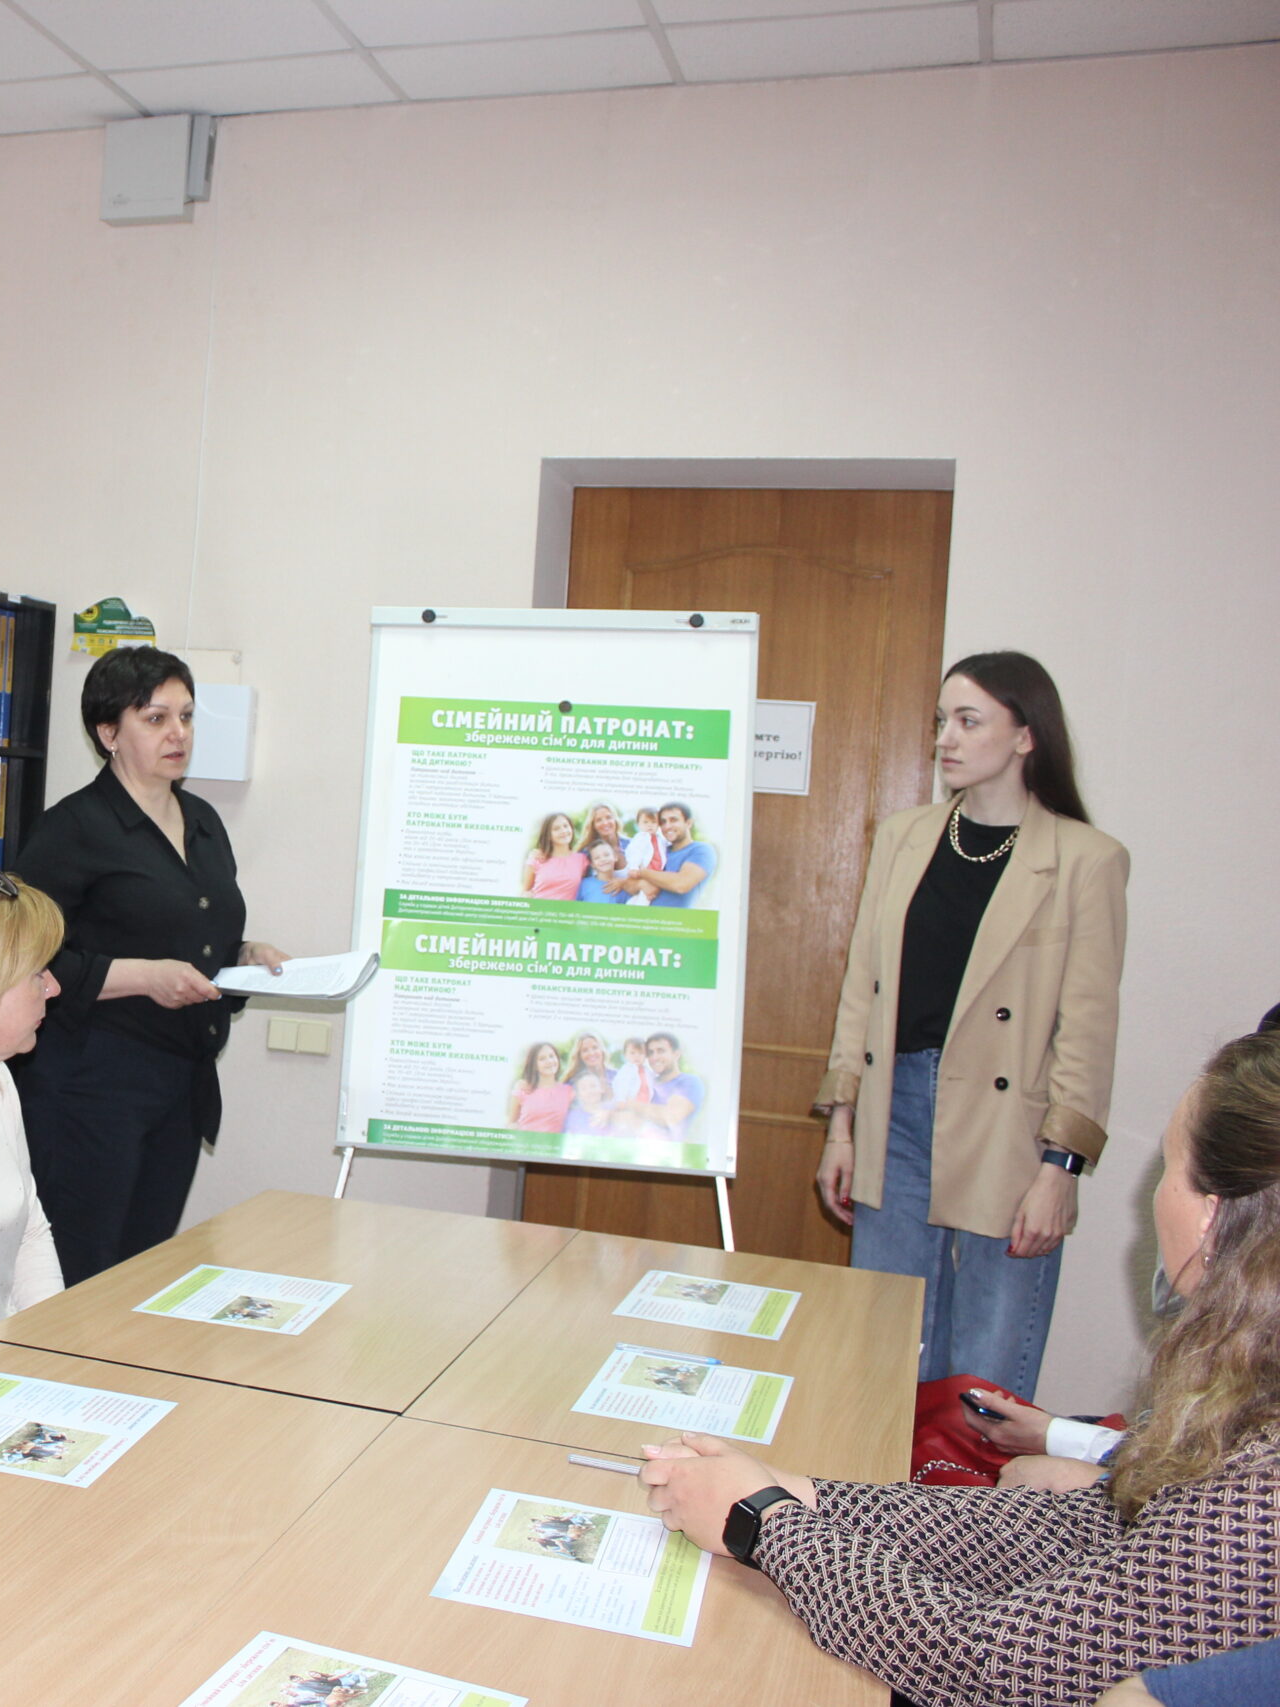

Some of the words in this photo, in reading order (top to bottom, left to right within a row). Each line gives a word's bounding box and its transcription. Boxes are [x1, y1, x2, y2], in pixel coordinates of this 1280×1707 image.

[432, 708, 553, 733] СІМЕЙНИЙ
[561, 715, 695, 740] ПАТРОНАТ:
[464, 731, 539, 749] збережемо
[541, 734, 577, 748] сім'ю
[580, 739, 605, 751] для
[608, 740, 658, 753] дитини
[415, 933, 538, 961] СІМЕЙНИЙ
[545, 942, 682, 968] ПАТРОНАТ:
[448, 958, 523, 976] збережемо
[526, 961, 563, 975] сім'ю
[566, 966, 591, 979] для
[594, 968, 645, 981] дитини
